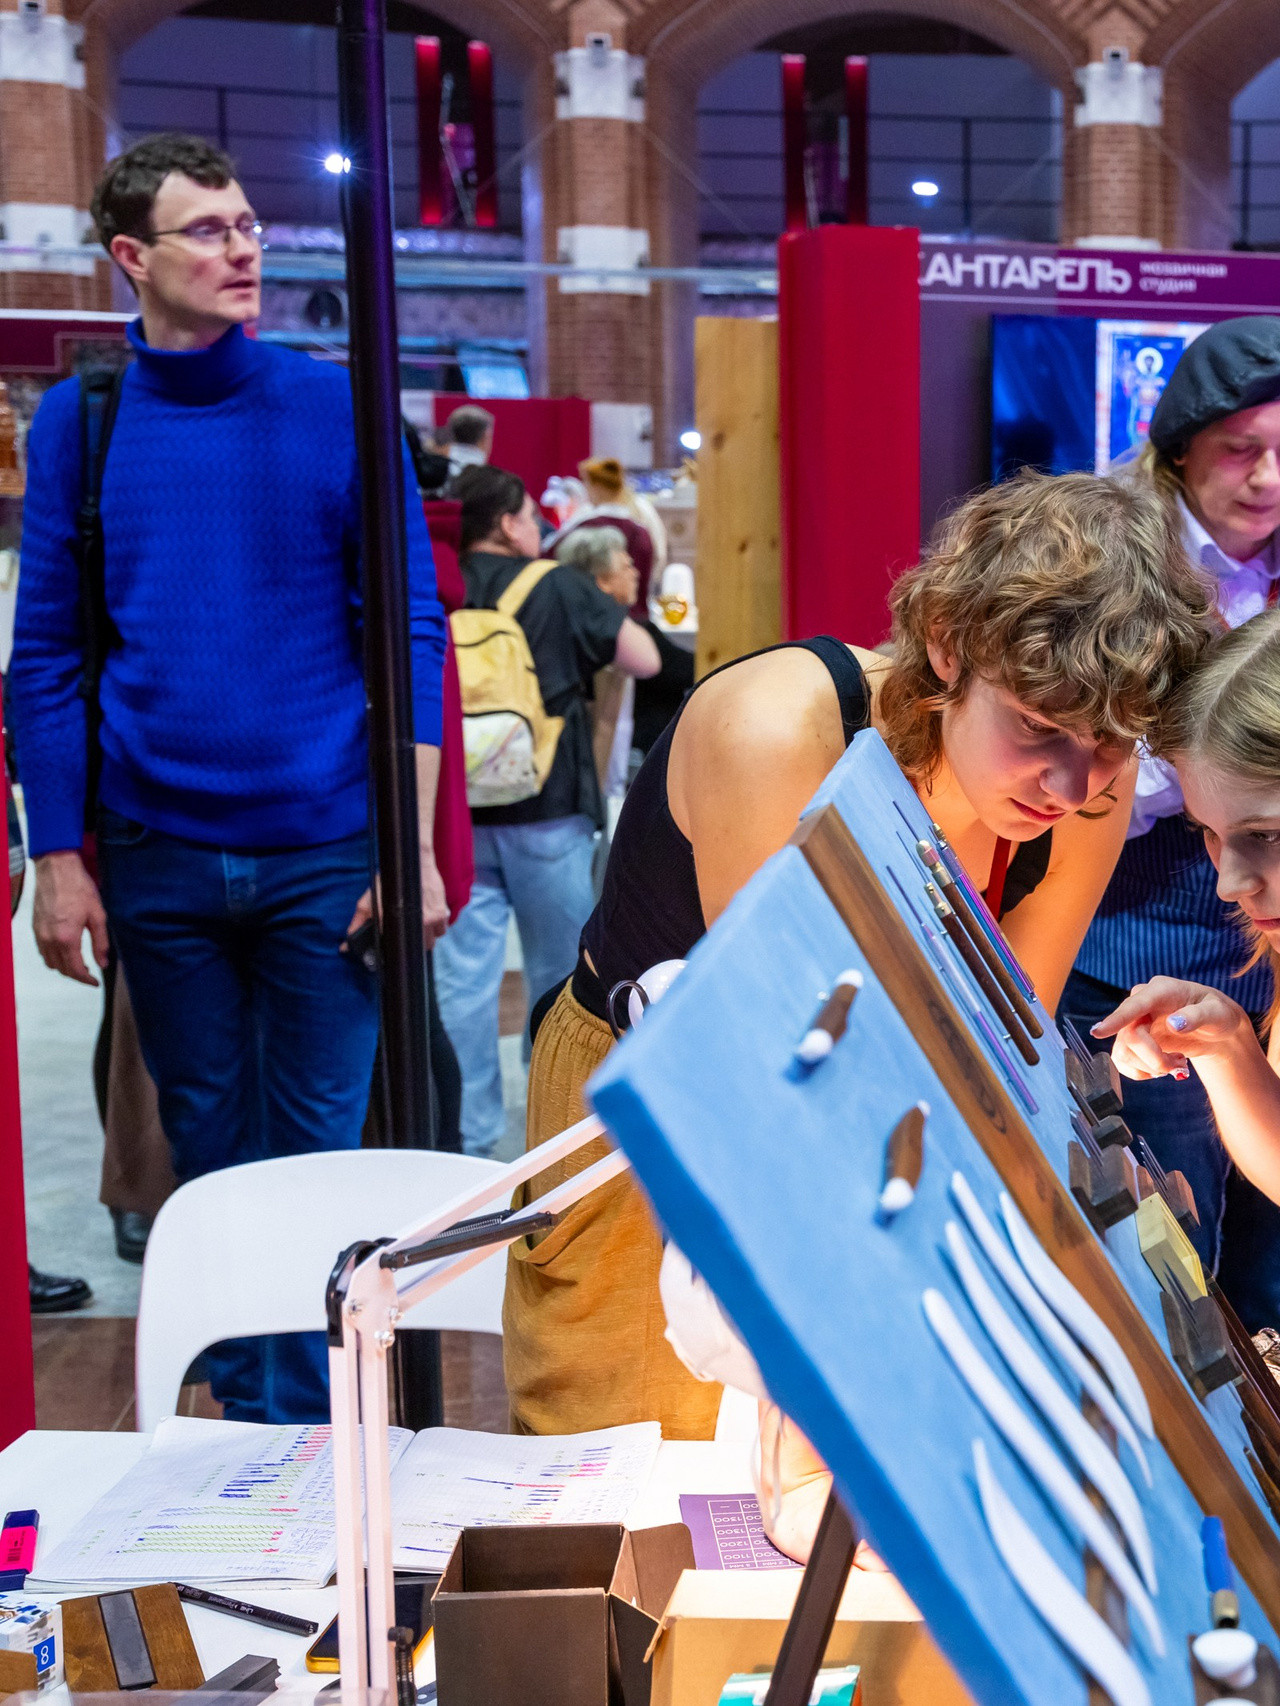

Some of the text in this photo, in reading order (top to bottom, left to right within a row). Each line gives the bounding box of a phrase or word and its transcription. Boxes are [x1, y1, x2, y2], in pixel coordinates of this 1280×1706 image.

[918, 252, 1132, 294] АНТАРЕЛЬ
[1139, 261, 1228, 278] мозаичная
[1139, 278, 1198, 295] студия
